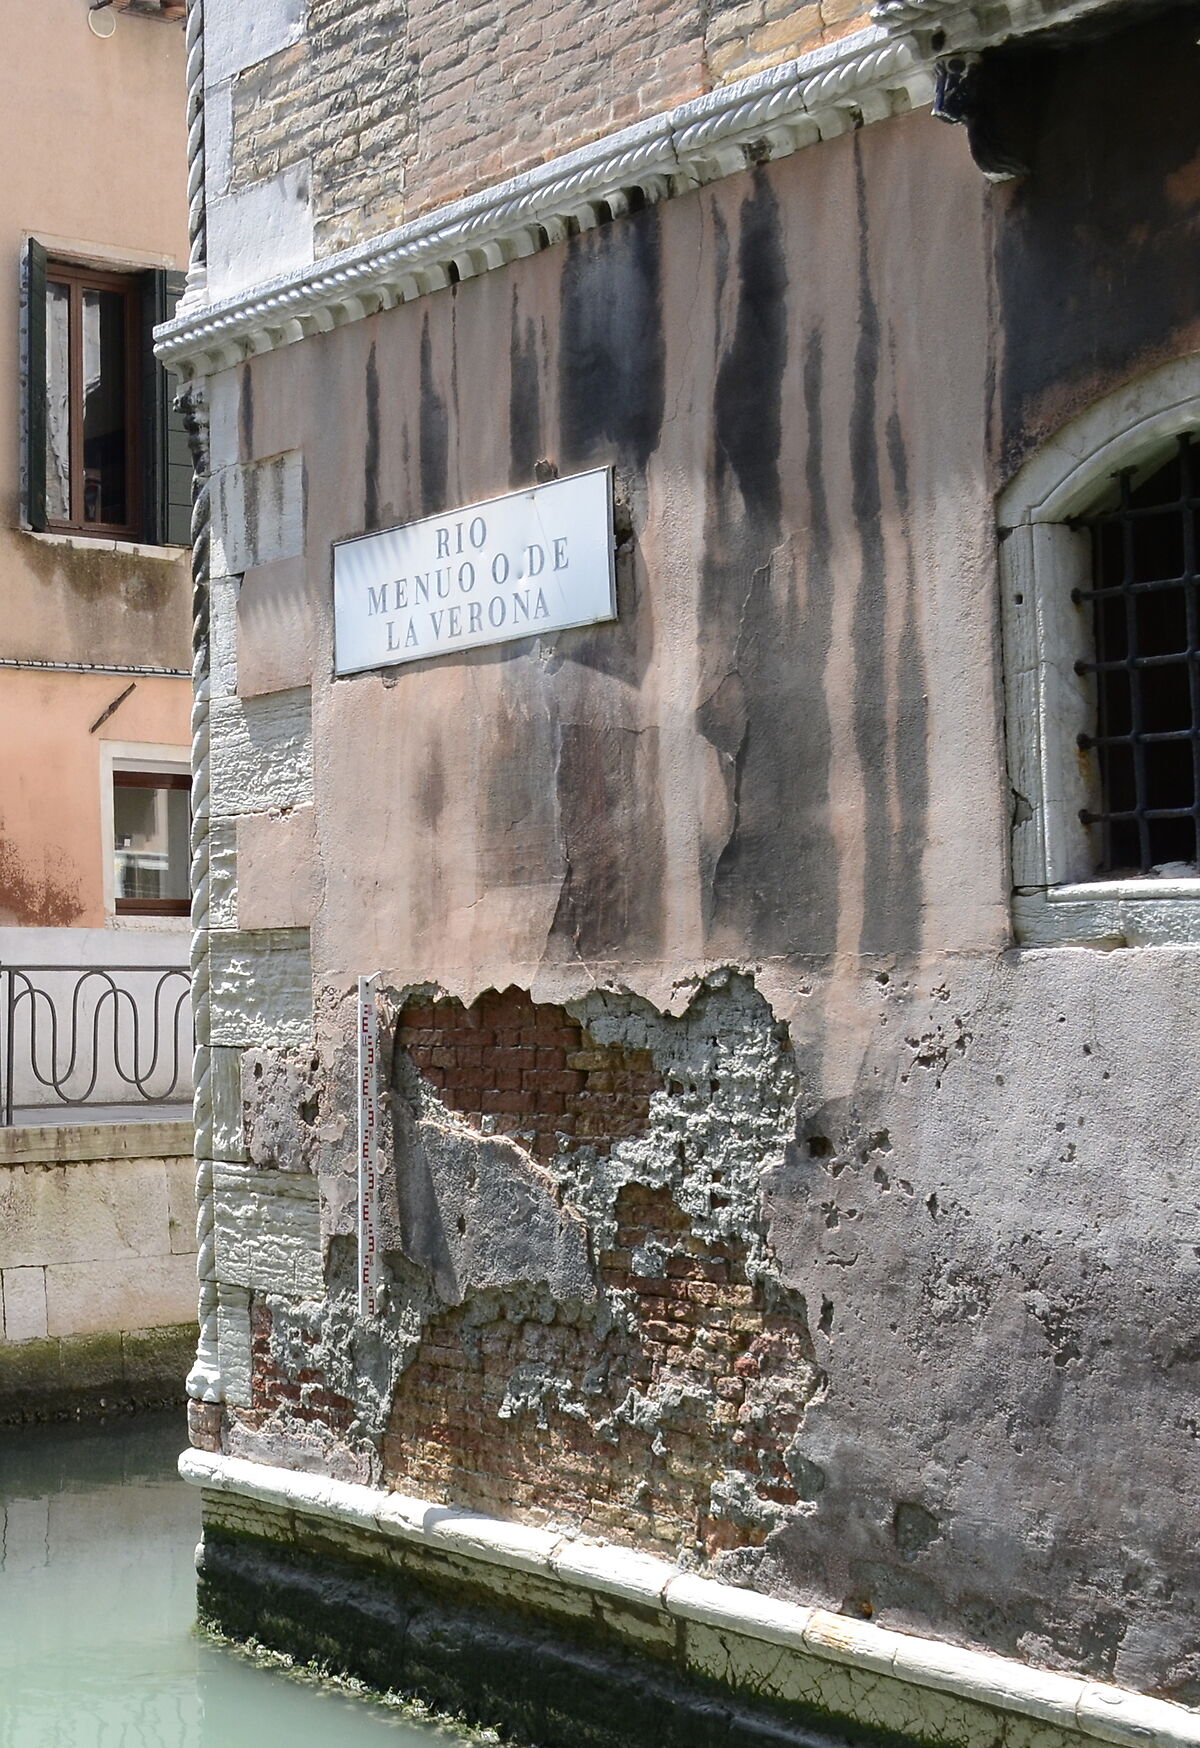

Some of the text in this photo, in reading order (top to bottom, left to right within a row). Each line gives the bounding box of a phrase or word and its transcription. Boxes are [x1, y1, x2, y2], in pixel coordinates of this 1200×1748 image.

[436, 517, 487, 560] RIO
[367, 536, 569, 617] MENUO O DE
[386, 587, 550, 652] LA VERONA
